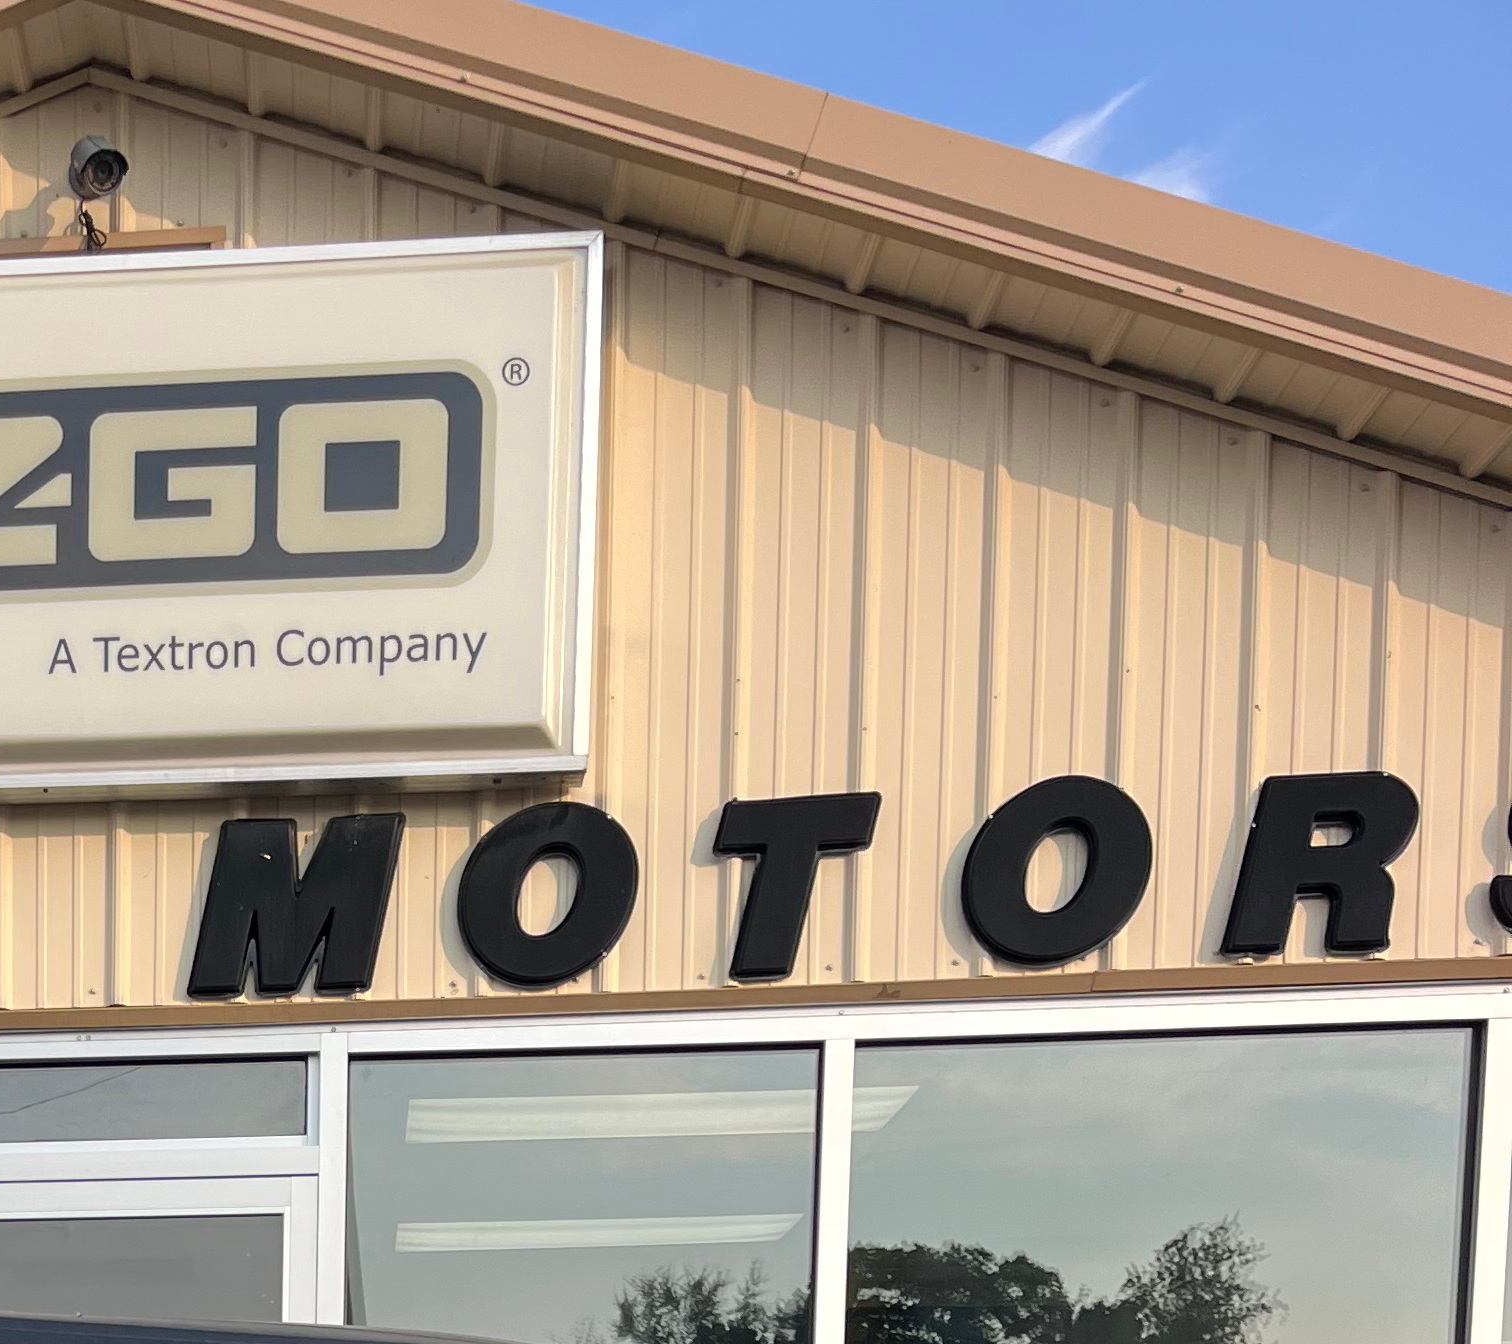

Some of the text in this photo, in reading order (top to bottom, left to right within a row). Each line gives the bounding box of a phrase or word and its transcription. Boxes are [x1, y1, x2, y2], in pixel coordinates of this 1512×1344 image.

[48, 627, 489, 676] A Textron Company
[186, 770, 1512, 1001] MOTOR
